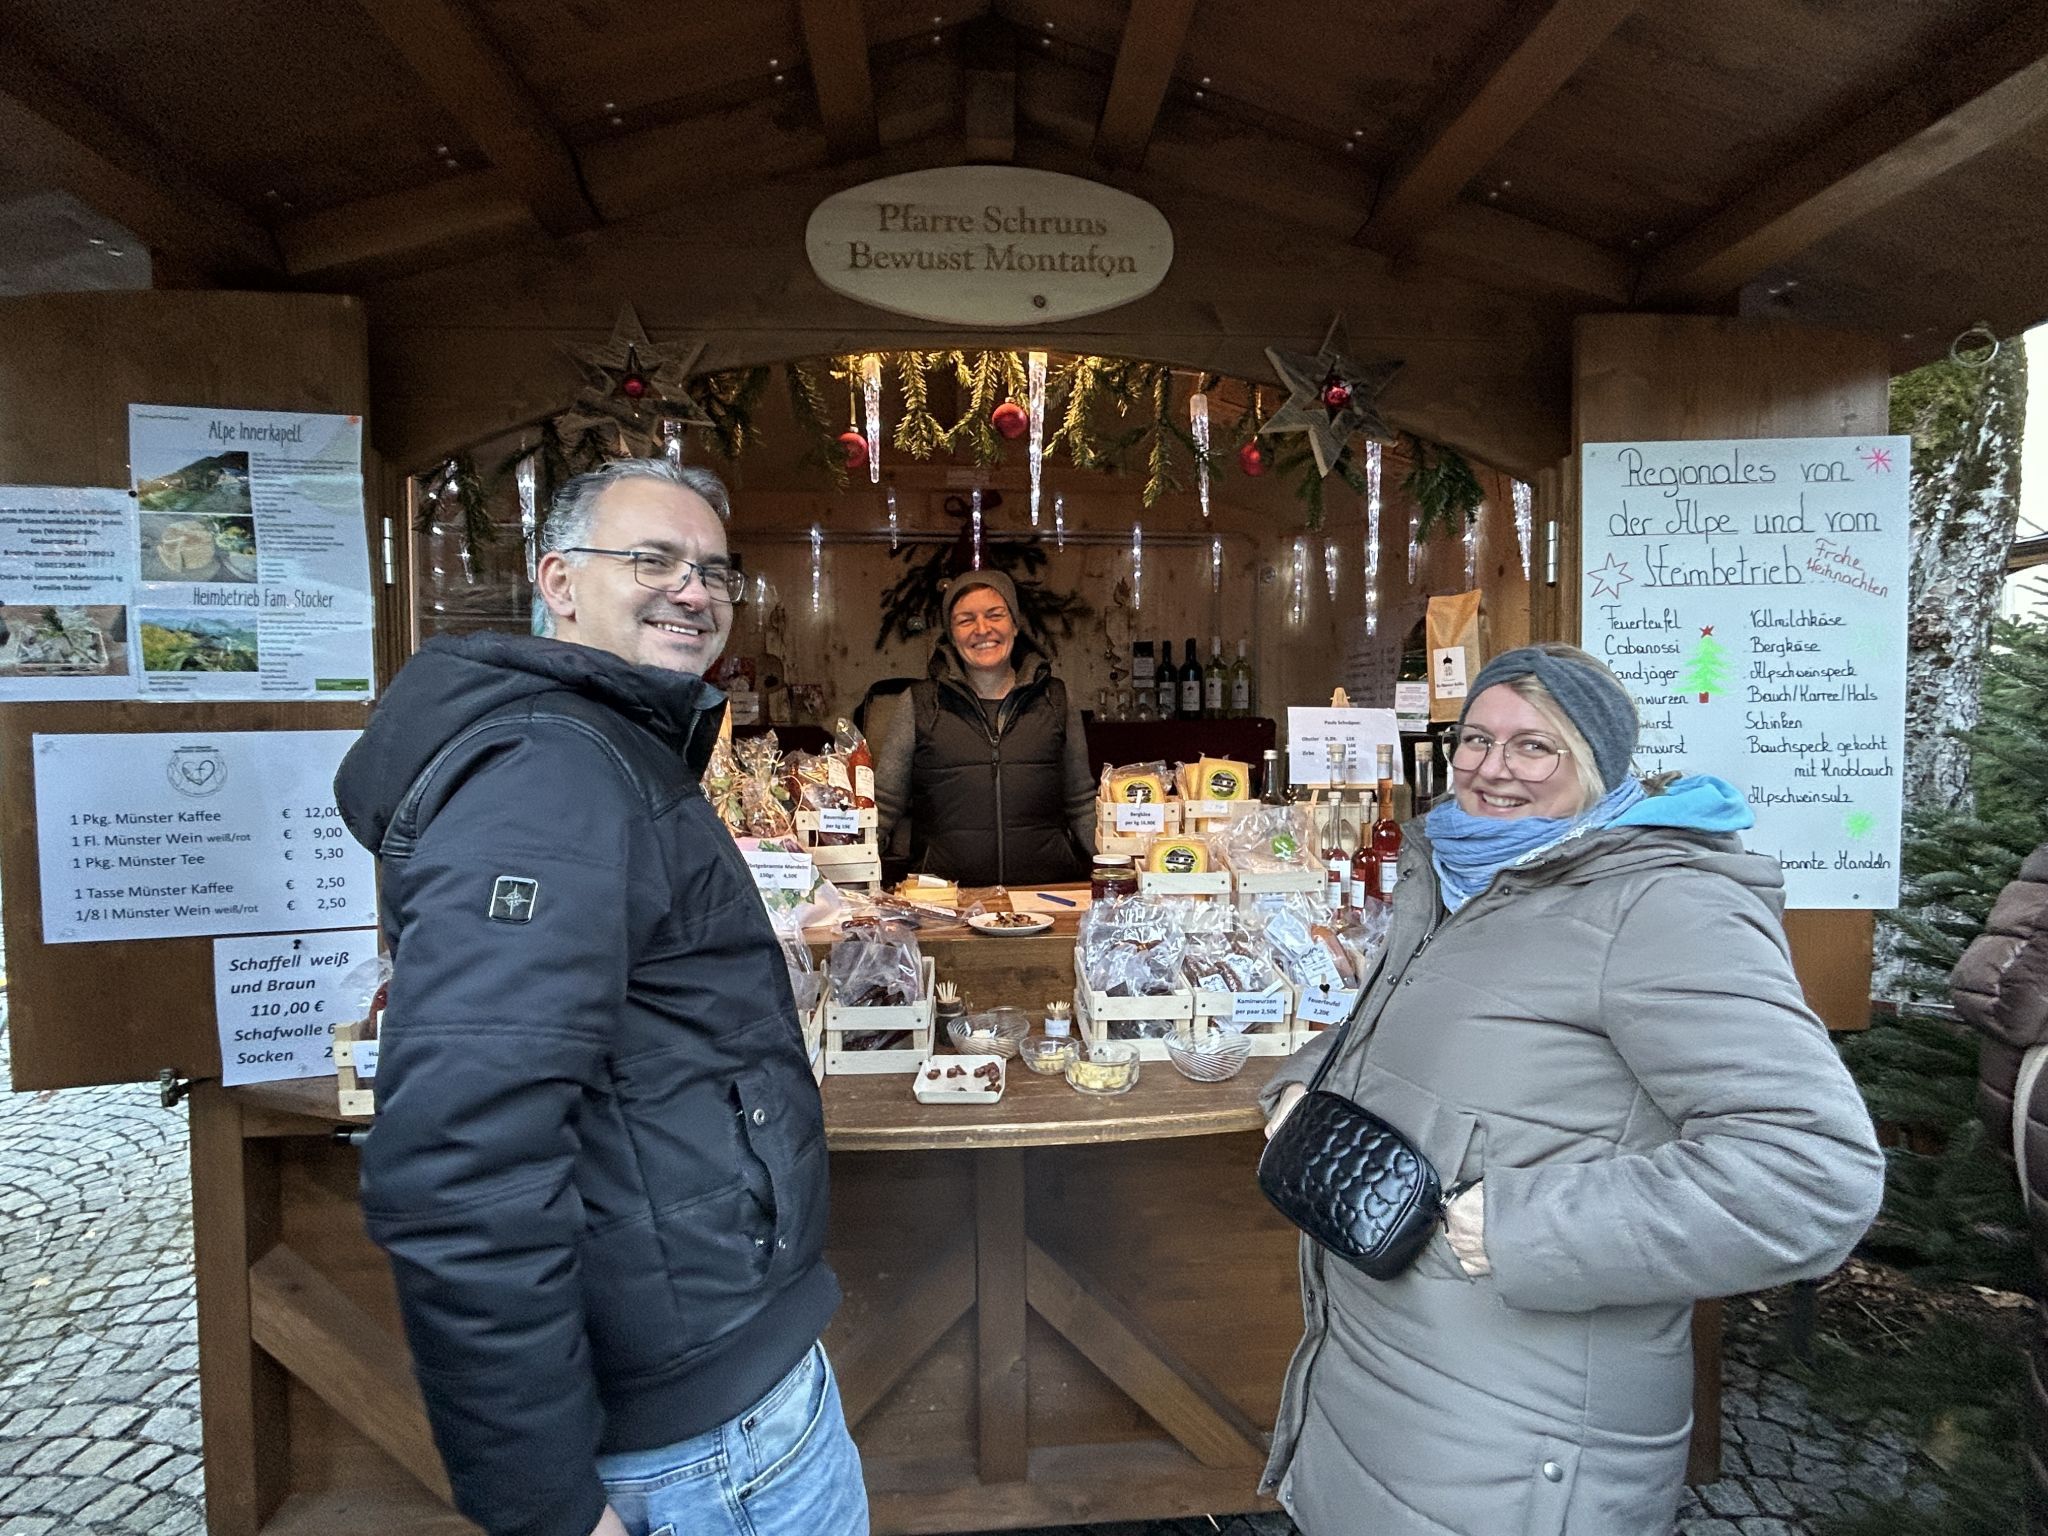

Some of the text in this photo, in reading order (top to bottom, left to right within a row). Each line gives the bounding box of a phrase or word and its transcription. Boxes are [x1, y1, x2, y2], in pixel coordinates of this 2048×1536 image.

[878, 203, 1108, 237] Pfarre Schruns
[847, 240, 1138, 277] Bewusst Montafon
[208, 421, 304, 448] Alpe Innerkapell
[1617, 447, 1854, 498] Regionales von
[1608, 492, 1883, 544] der Alpe und vom
[1815, 537, 1865, 572] Frohe
[193, 587, 334, 609] Heimbetrieb Fam. Stocker
[1600, 604, 1682, 632] Feuerteufel
[1604, 634, 1680, 655] Cabanossi
[1751, 636, 1822, 657] Bergkäse
[1634, 693, 1689, 706] inwurzen
[1744, 710, 1803, 731] Schinken
[1747, 733, 1888, 760] Bauchspeck gekocht
[1794, 756, 1894, 778] mit Knoblauch
[70, 806, 342, 828] 1 Pkg. Münster Kaffee € 12,00
[72, 827, 343, 847] 1 Fl. Münster Wein weiß/rot € 9,00
[73, 848, 344, 871] 1 Pkg. Münster Tee € 5,30
[75, 877, 345, 899] 1 Tasse Münster Kaffee € 2,50
[75, 909, 100, 922] 1/8
[111, 906, 170, 920] Münster
[173, 904, 210, 918] Wein
[214, 903, 259, 915] weiß/rot
[287, 900, 296, 911] €
[317, 897, 346, 911] 2,50
[229, 951, 350, 972] Schaffell weiß
[230, 979, 316, 994] und Braun
[314, 1000, 325, 1013] €
[234, 1022, 337, 1041] Schafwolle 6
[236, 1046, 334, 1065] Socken 2
